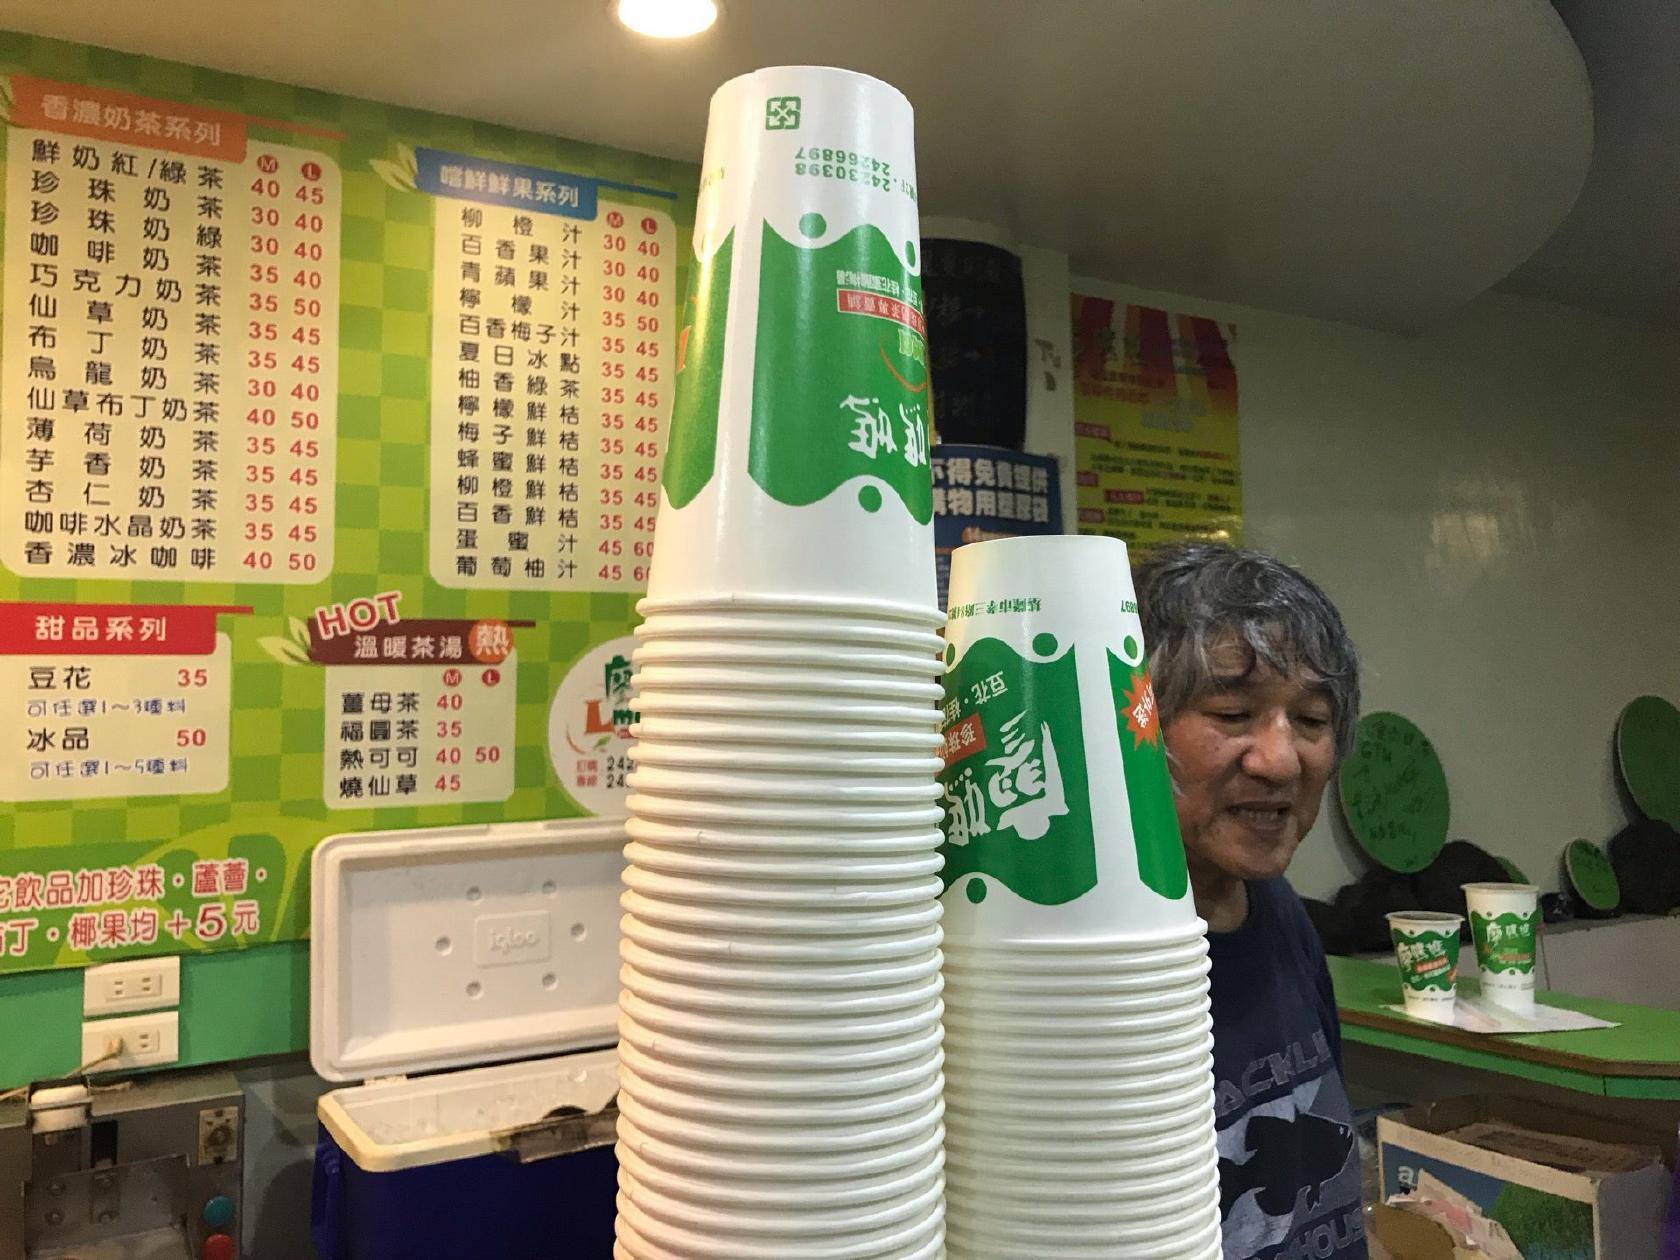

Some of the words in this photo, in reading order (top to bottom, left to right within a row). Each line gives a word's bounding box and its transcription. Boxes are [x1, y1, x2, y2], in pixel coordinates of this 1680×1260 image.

[41, 94, 221, 147] 香濃奶茶系列
[32, 139, 223, 190] 鮮奶紅/綠茶
[251, 178, 280, 198] 40
[295, 185, 324, 205] 45
[31, 170, 223, 219] 珍珠奶茶
[251, 206, 280, 227] 30
[295, 213, 323, 233] 40
[31, 201, 222, 249] 珍珠奶綠
[250, 235, 279, 255] 30
[294, 243, 322, 261] 40
[461, 206, 582, 243] 柳橙汁
[603, 234, 625, 251] 30
[638, 240, 659, 257] 40
[30, 233, 222, 277] 咖啡奶茶
[250, 264, 279, 284] 35
[293, 270, 321, 289] 40
[461, 234, 582, 270] 百香果汁
[603, 259, 625, 277] 30
[637, 266, 659, 282] 40
[30, 263, 222, 307] 巧克力奶茶
[249, 293, 278, 312] 35
[293, 299, 321, 317] 50
[460, 261, 581, 296] 青蘋果汁
[603, 285, 625, 302] 30
[637, 291, 659, 307] 40
[29, 294, 221, 336] 仙草奶茶
[249, 322, 278, 341] 35
[292, 327, 321, 345] 45
[459, 287, 580, 322] 檸檬汁
[602, 311, 625, 327] 35
[637, 316, 658, 332] 50
[28, 325, 221, 365] 布丁奶茶
[248, 351, 277, 369] 35
[291, 355, 320, 373] 45
[459, 313, 580, 348] 百香梅子汁
[602, 336, 625, 353] 35
[636, 341, 658, 357] 45
[28, 355, 220, 395] 烏龍奶茶
[247, 380, 276, 398] 30
[291, 383, 319, 401] 40
[459, 340, 580, 374] 夏日冰點
[601, 361, 624, 379] 35
[635, 366, 658, 383] 45
[27, 386, 219, 424] 仙草布丁奶茶
[247, 408, 275, 426] 40
[291, 411, 319, 429] 50
[458, 367, 580, 400] 柚香綠茶
[601, 387, 624, 404] 35
[635, 391, 658, 408] 45
[458, 394, 579, 425] 檸檬鮮桔
[601, 413, 624, 430] 35
[635, 417, 658, 433] 45
[26, 416, 219, 452] 薄荷奶茶
[246, 437, 276, 454] 35
[290, 440, 319, 457] 45
[458, 421, 579, 452] 梅子鮮桔
[601, 438, 623, 455] 35
[635, 442, 657, 458] 45
[26, 448, 218, 482] 芋香奶茶
[246, 466, 275, 484] 35
[290, 468, 318, 486] 45
[457, 448, 579, 477] 蜂蜜鮮桔
[600, 464, 623, 480] 35
[634, 467, 657, 483] 45
[25, 480, 218, 511] 杏仁奶茶
[245, 494, 274, 512] 35
[289, 497, 318, 514] 45
[457, 475, 579, 504] 柳橙鮮桔
[600, 489, 623, 506] 35
[634, 492, 657, 508] 45
[25, 510, 217, 540] 咖啡水晶奶茶
[244, 523, 273, 541] 35
[289, 525, 317, 542] 45
[457, 501, 578, 529] 百香鮮桔
[600, 514, 623, 531] 35
[634, 516, 656, 532] 45
[24, 541, 216, 570] 香濃冰咖啡
[243, 551, 272, 569] 40
[289, 554, 316, 571] 50
[456, 528, 578, 554] 蛋蜜汁
[598, 540, 622, 557] 45
[456, 555, 578, 580] 葡萄柚汁
[598, 565, 622, 581] 45
[633, 566, 650, 582] 6
[35, 615, 167, 642] 甜品系列
[317, 593, 401, 639] HOT
[354, 634, 463, 659] 溫暖茶湯
[477, 623, 510, 656] 熱
[28, 665, 91, 690] 豆花
[177, 668, 208, 687] 35
[341, 692, 420, 714] 薑母茶
[436, 694, 463, 711] 40
[27, 727, 89, 752] 冰品
[176, 729, 207, 747] 50
[340, 719, 420, 743] 福圓茶
[436, 721, 462, 738] 35
[340, 746, 418, 770] 熱可可
[435, 747, 462, 765] 40
[474, 746, 500, 764] 50
[339, 774, 418, 799] 燒仙草
[434, 774, 462, 792] 45
[0, 902, 258, 953] 丁·椰果均+5元
